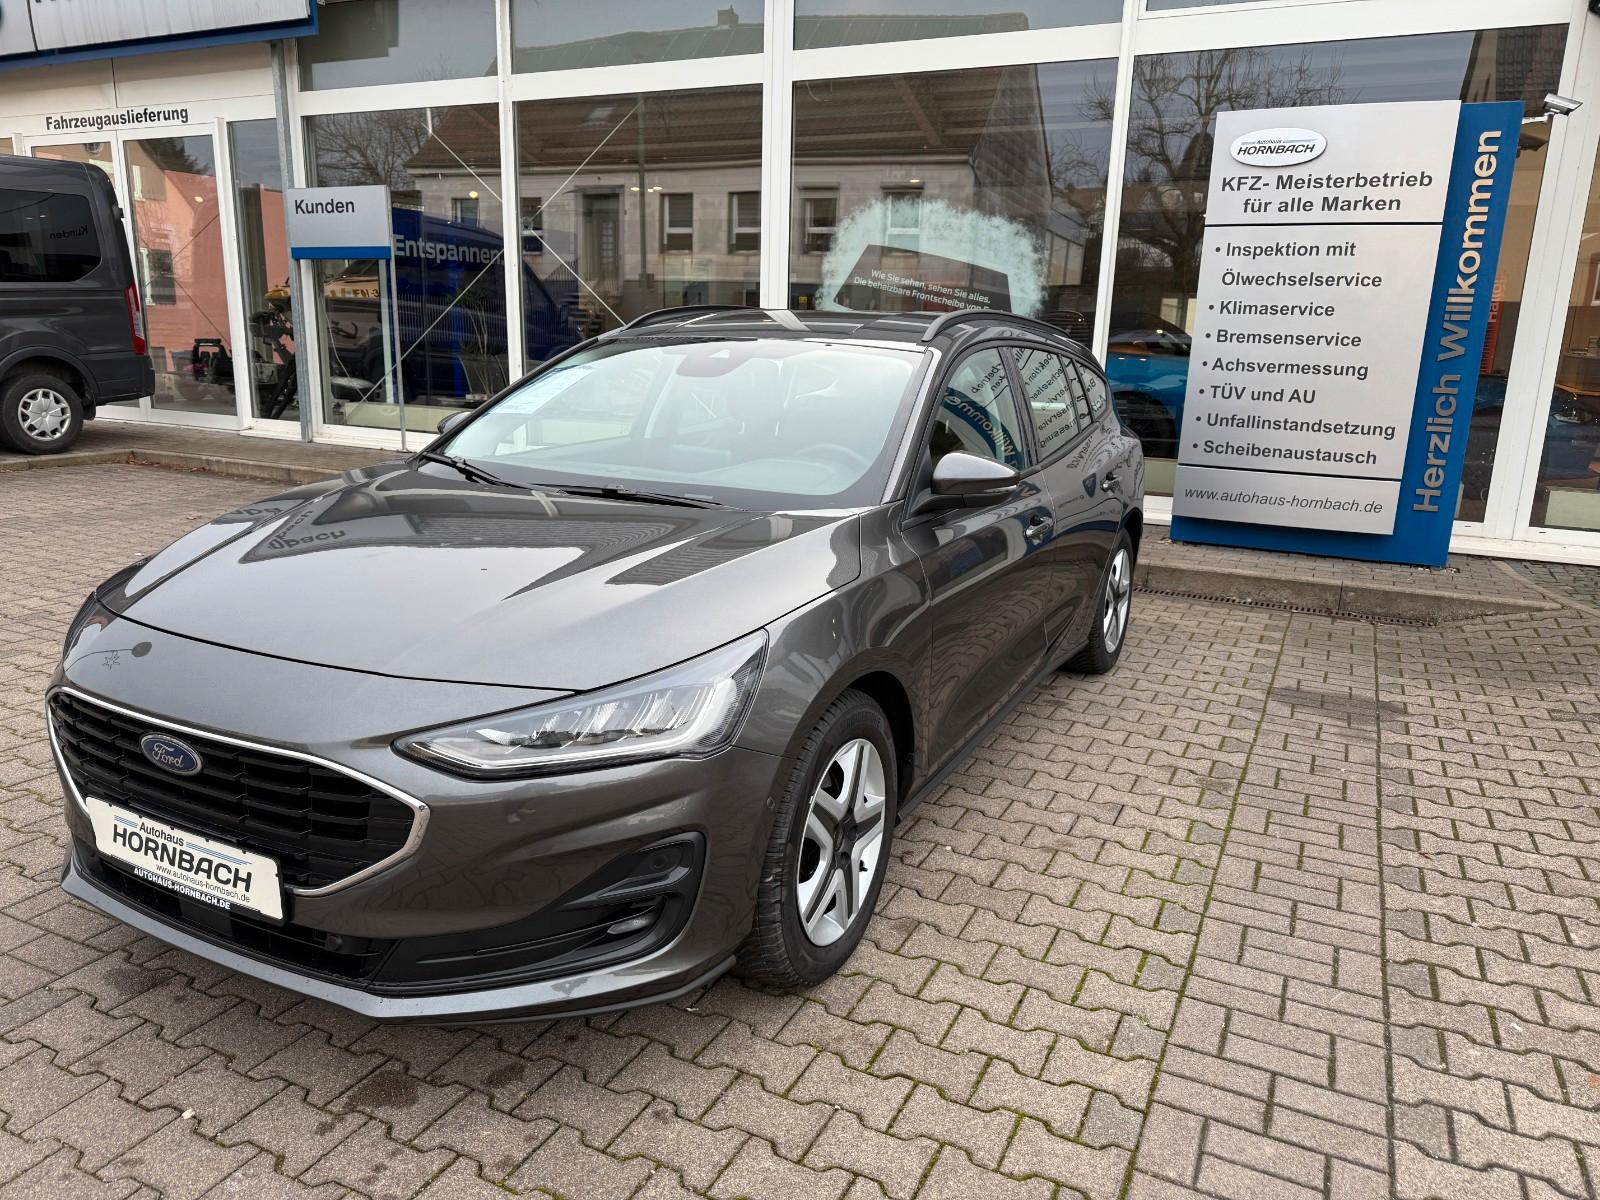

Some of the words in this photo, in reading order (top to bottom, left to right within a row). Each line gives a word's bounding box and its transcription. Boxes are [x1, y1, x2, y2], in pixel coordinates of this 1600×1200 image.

[45, 108, 189, 131] Fahrzeugauslieferung
[1237, 143, 1316, 156] HORNBACH
[1221, 175, 1270, 191] KFZ-
[1275, 171, 1433, 190] Meisterbetrieb
[295, 199, 355, 215] Kunden
[1243, 198, 1272, 213] für
[1277, 197, 1314, 212] alle
[1321, 196, 1401, 212] Marken
[1226, 242, 1320, 260] Inspektion
[1326, 241, 1357, 257] mit
[1437, 130, 1502, 362] Willkommen
[871, 269, 886, 279] Wie
[887, 273, 900, 283] Sie
[900, 277, 926, 290] sehen,
[928, 282, 953, 295] sehen
[954, 288, 968, 298] Sie
[968, 292, 991, 304] alles.
[1221, 268, 1382, 288] Ölwechselservice
[854, 277, 867, 286] Die
[867, 280, 911, 296] beheizbare
[911, 289, 965, 309] Frontscheibe
[1219, 300, 1335, 317] Klimaservice
[1216, 329, 1362, 348] Bremsenservice
[1211, 357, 1369, 381] Achsvermessung
[1210, 383, 1246, 400] TÜV
[1250, 387, 1284, 402] und
[1288, 388, 1316, 404] AU
[1207, 412, 1396, 440] Unfallinstandsetzung
[1203, 440, 1377, 465] Scheibenaustausch
[1413, 374, 1462, 512] Herzlich
[1185, 486, 1383, 515] www.autohaus-hornbach.de
[152, 742, 185, 768] Ford
[139, 822, 185, 847] Autohaus
[112, 824, 252, 893] HORNBACH
[134, 867, 231, 910] AUTOHAUS-HORNBACH.DE
[155, 864, 250, 903] www.autohaus-hornbach.de
